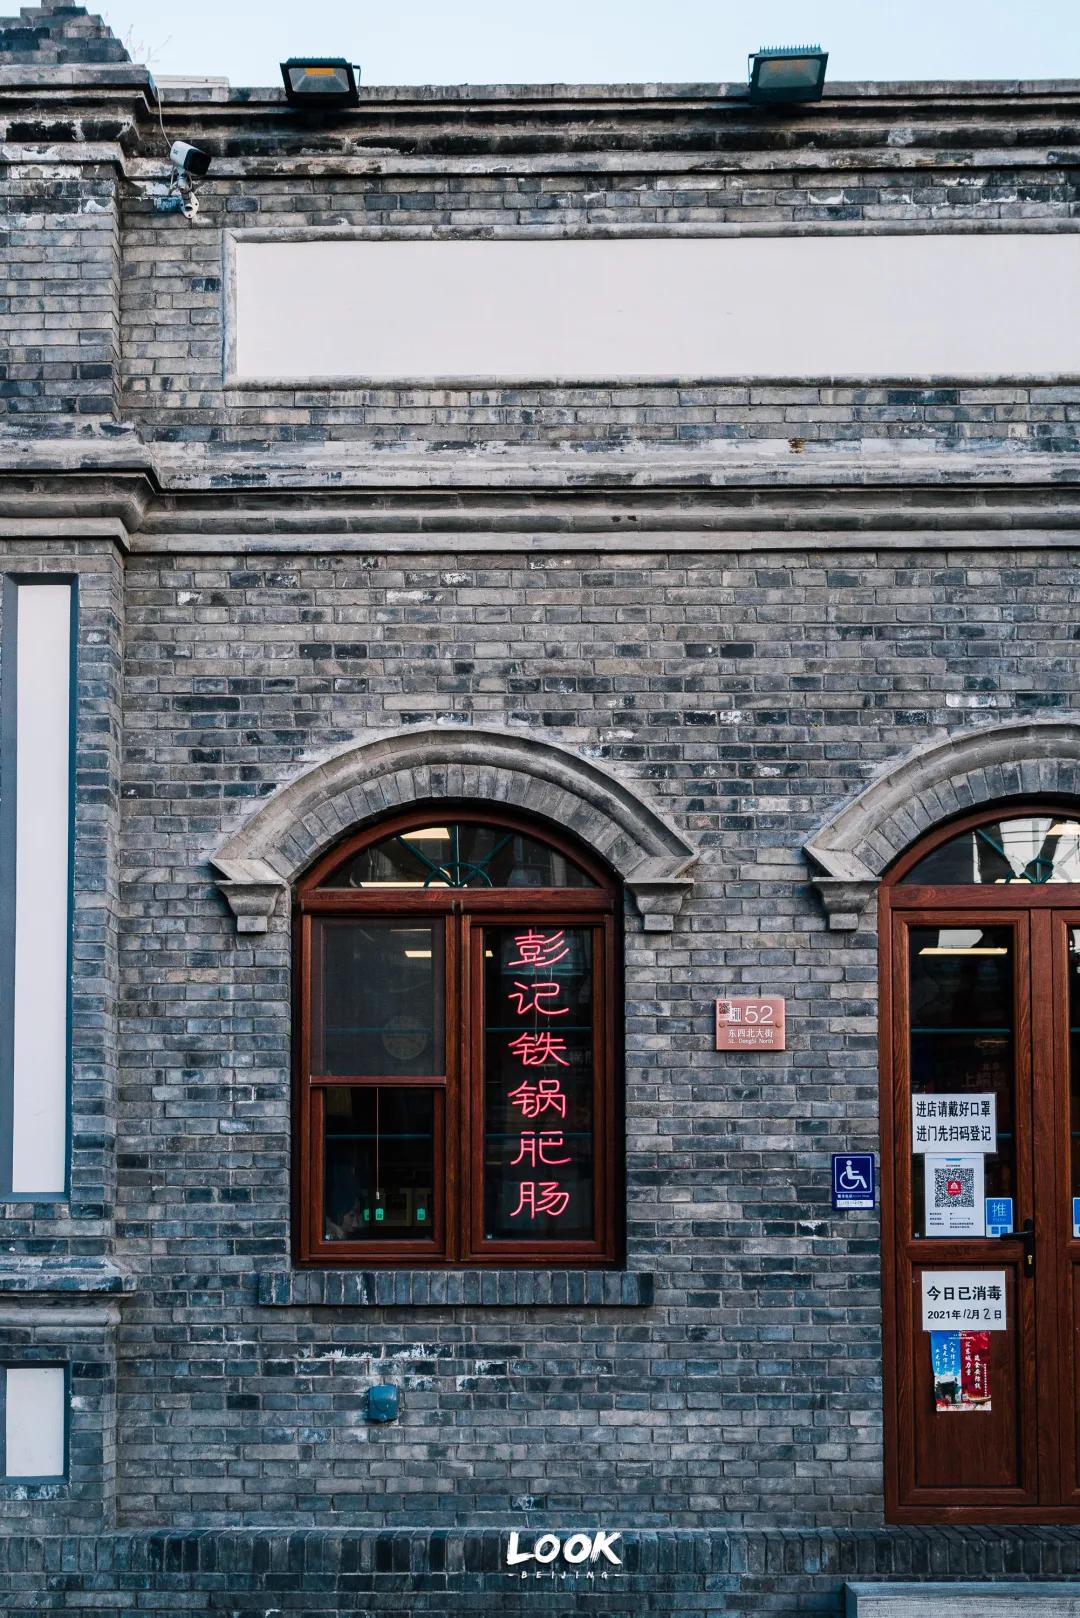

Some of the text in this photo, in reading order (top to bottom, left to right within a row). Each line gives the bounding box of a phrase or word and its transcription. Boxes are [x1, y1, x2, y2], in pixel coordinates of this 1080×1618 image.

[744, 1005, 774, 1024] 52
[728, 1028, 774, 1038] 东四北大街
[507, 929, 573, 1220] 彭记铁锅肥肠
[916, 1100, 991, 1118] 进店请戴好口罩
[916, 1125, 992, 1142] 进门先扫码登记
[991, 1202, 1007, 1218] 推
[926, 1285, 1002, 1301] 今日已消毒
